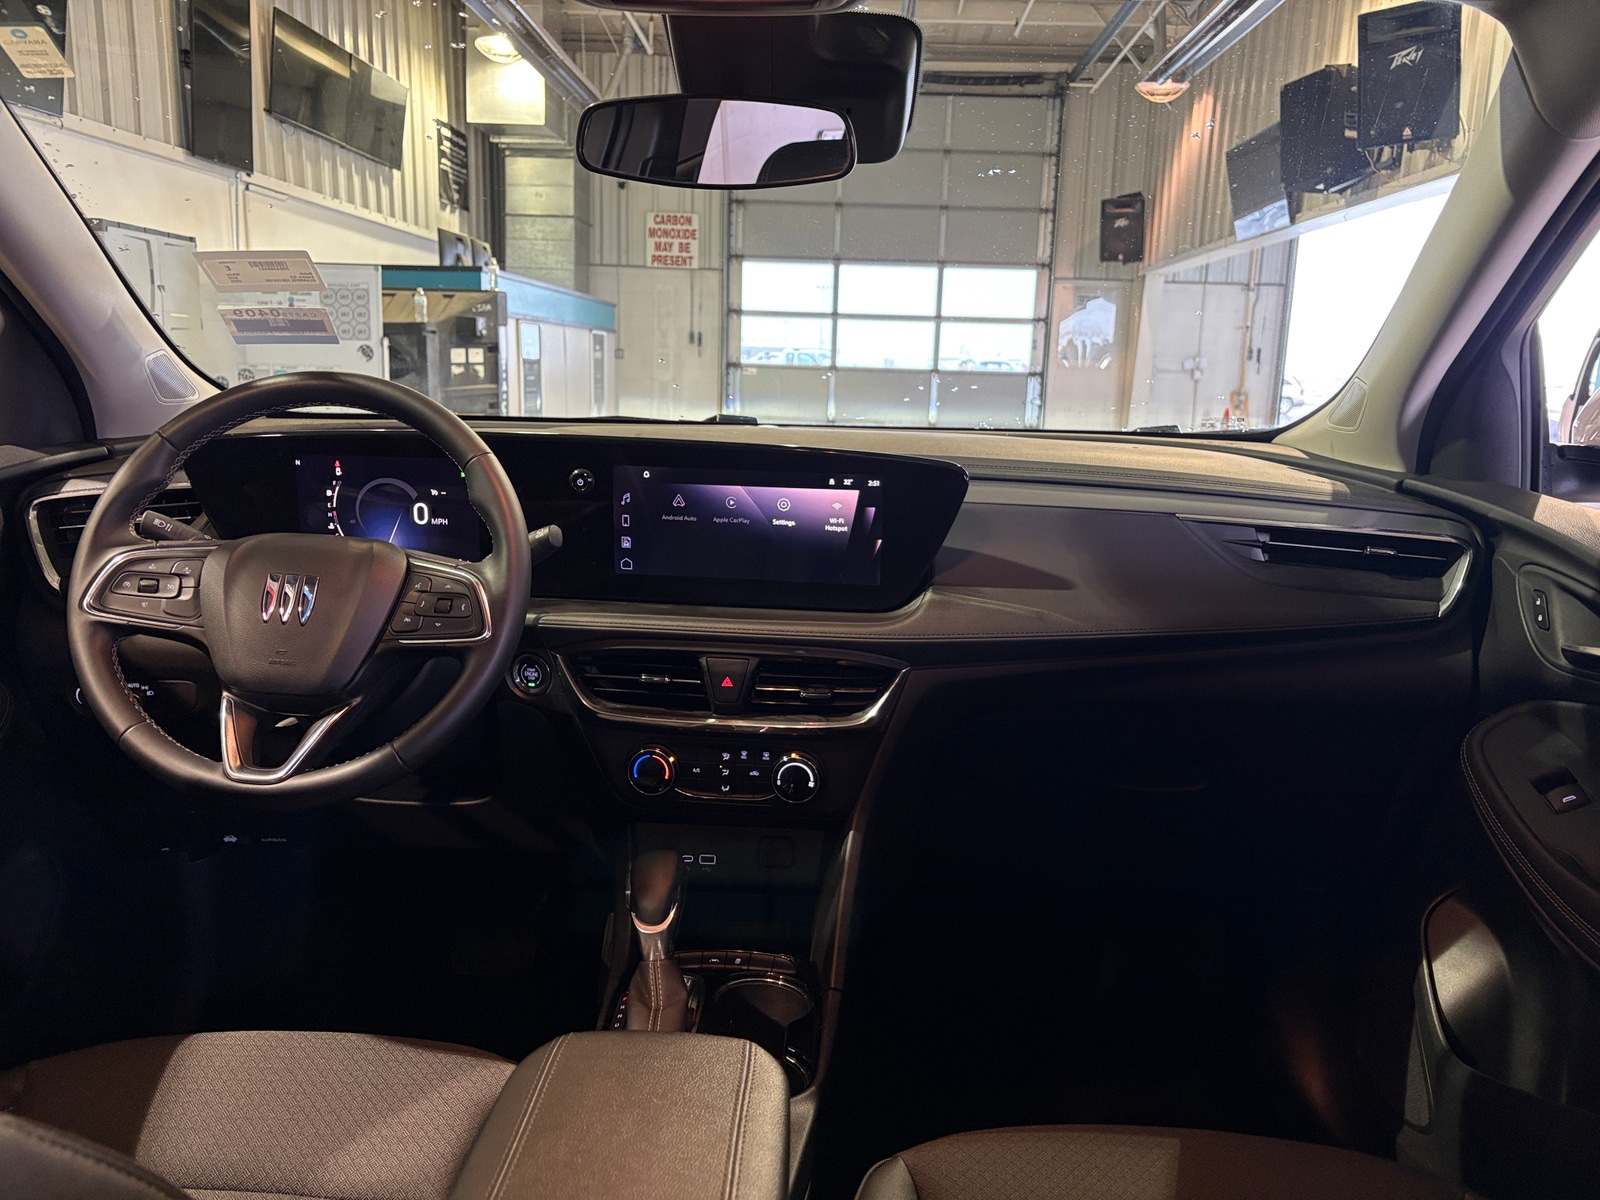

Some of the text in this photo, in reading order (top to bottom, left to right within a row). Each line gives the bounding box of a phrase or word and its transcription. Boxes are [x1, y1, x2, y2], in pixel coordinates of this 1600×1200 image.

[653, 214, 692, 226] CARBON
[648, 227, 697, 240] MONOXIDE
[654, 241, 692, 253] MAY BE
[651, 254, 694, 267] PRESENT
[413, 502, 429, 525] 0
[713, 516, 750, 525] Apple CarPlay
[772, 518, 796, 527] Settings
[825, 525, 848, 533] Hotspot
